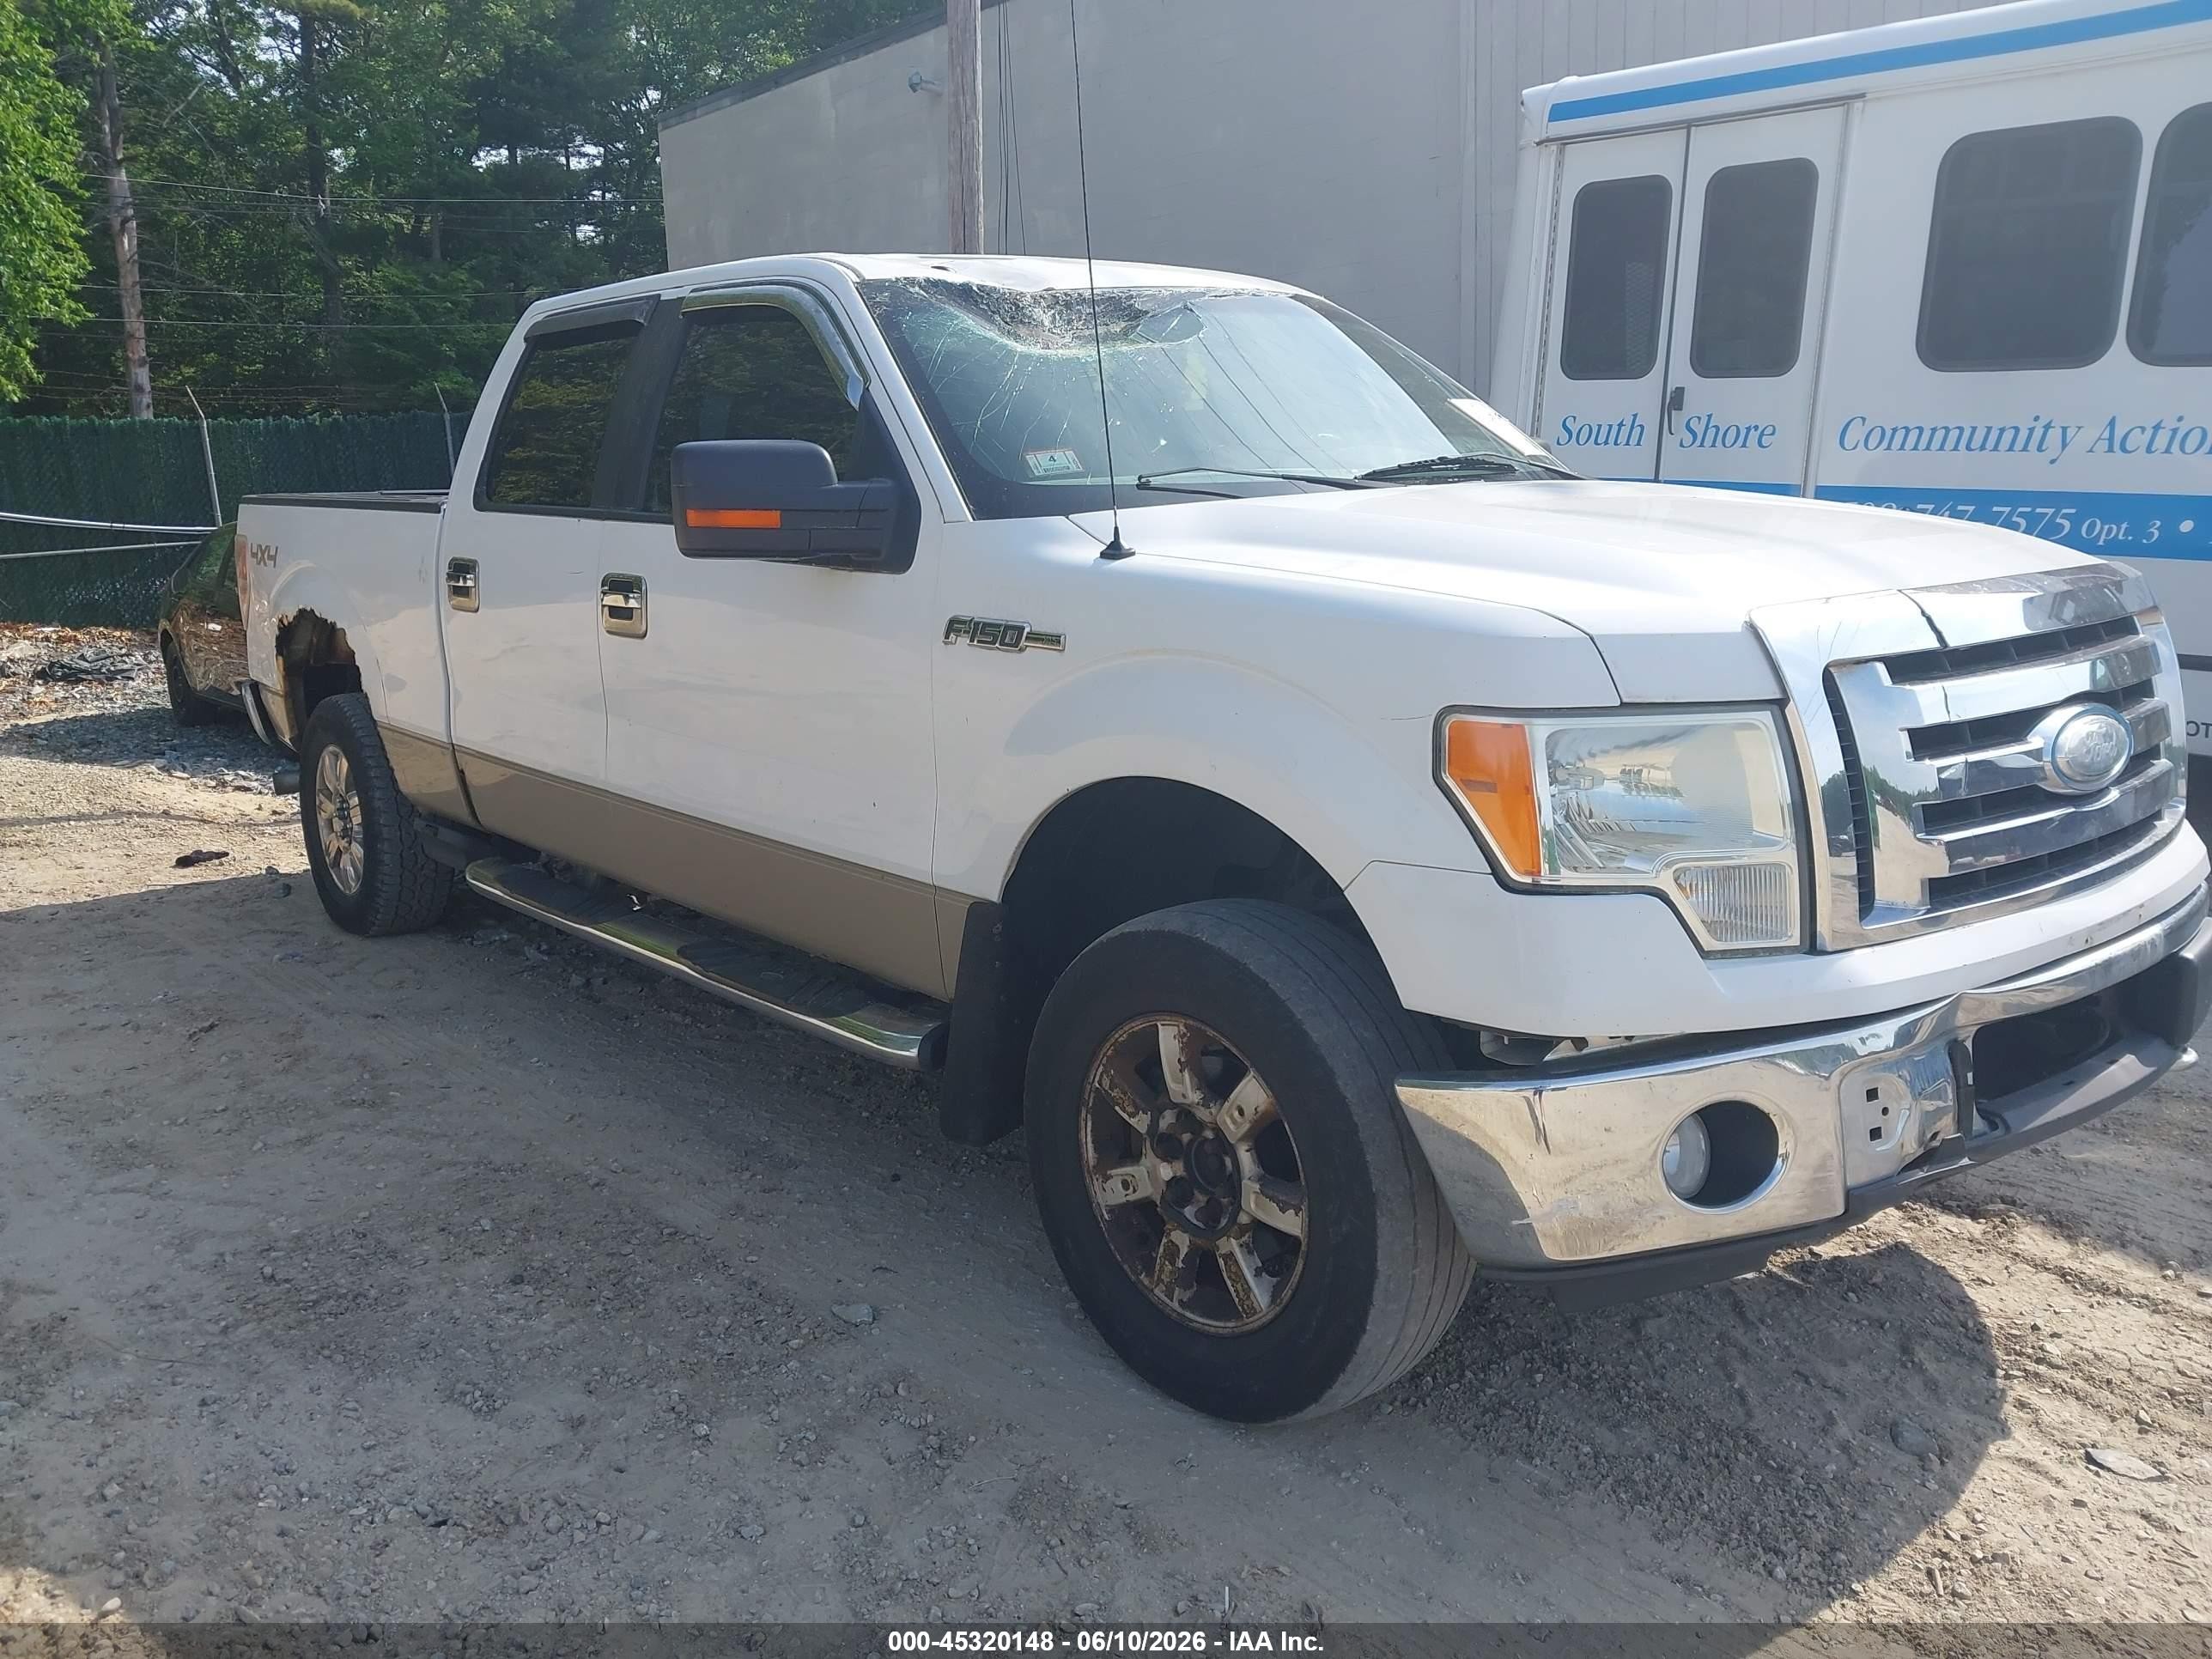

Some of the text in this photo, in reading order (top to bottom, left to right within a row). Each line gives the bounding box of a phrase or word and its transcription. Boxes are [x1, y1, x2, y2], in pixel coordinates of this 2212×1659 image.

[1556, 412, 1645, 447] South
[1679, 412, 1777, 449] Shore
[1838, 415, 2084, 465] Community
[2081, 517, 2134, 545] Opt.
[2142, 520, 2162, 544] 3
